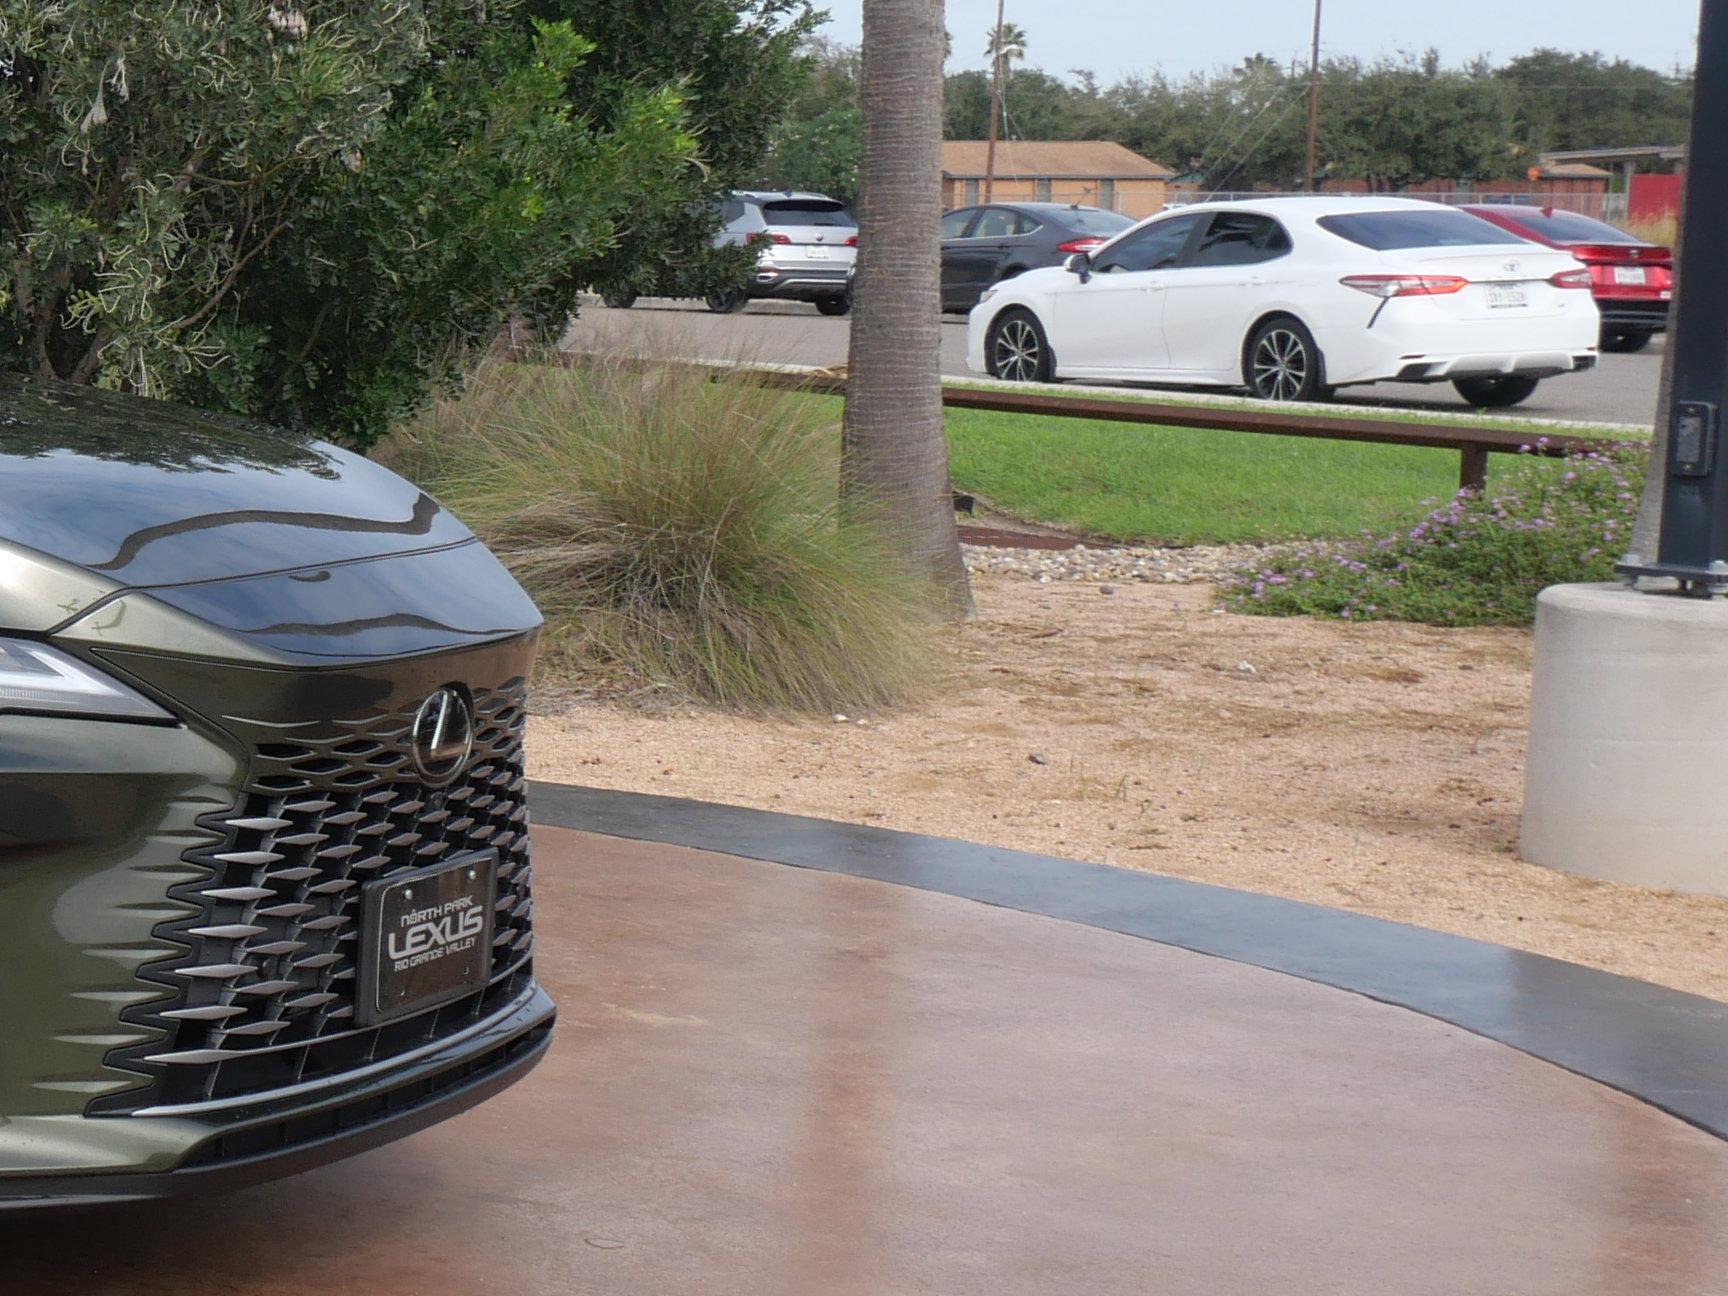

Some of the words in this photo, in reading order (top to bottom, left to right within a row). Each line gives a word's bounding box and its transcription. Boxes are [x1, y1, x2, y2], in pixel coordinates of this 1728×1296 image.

[401, 906, 442, 927] NORTH
[445, 896, 473, 914] PARK
[388, 905, 484, 960] LEXUS
[394, 959, 409, 971] RIO
[409, 947, 444, 967] GRANDE
[446, 936, 476, 955] VALLEY
